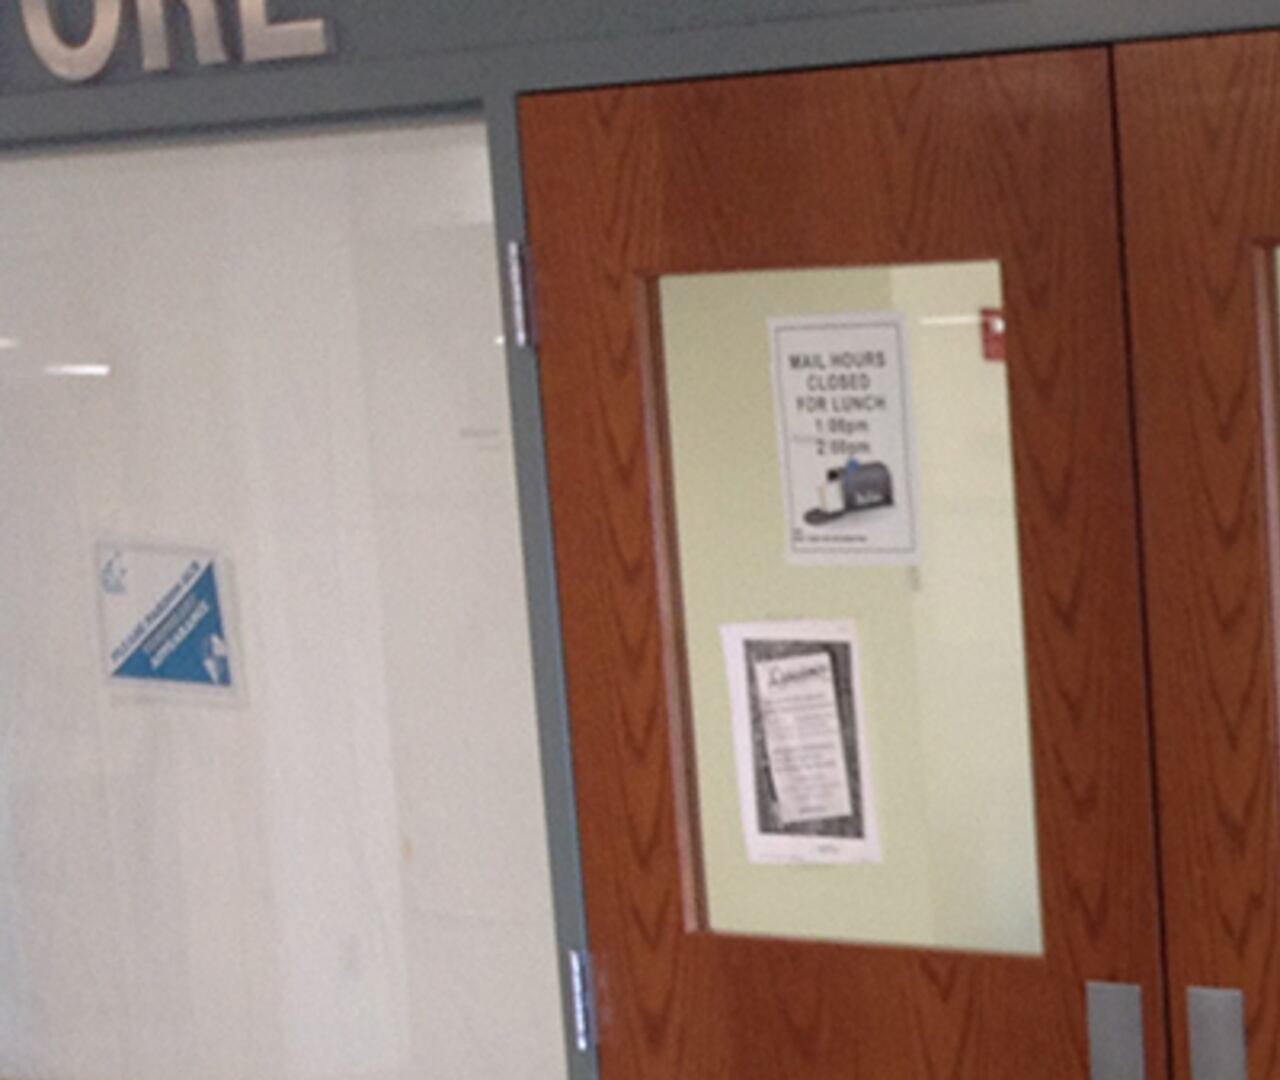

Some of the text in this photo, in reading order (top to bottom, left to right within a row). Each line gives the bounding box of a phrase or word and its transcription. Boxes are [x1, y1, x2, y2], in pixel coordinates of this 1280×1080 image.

[789, 351, 886, 370] MAIL HOURS
[806, 373, 871, 391] CLOSED
[797, 395, 887, 413] FOR LUNCH
